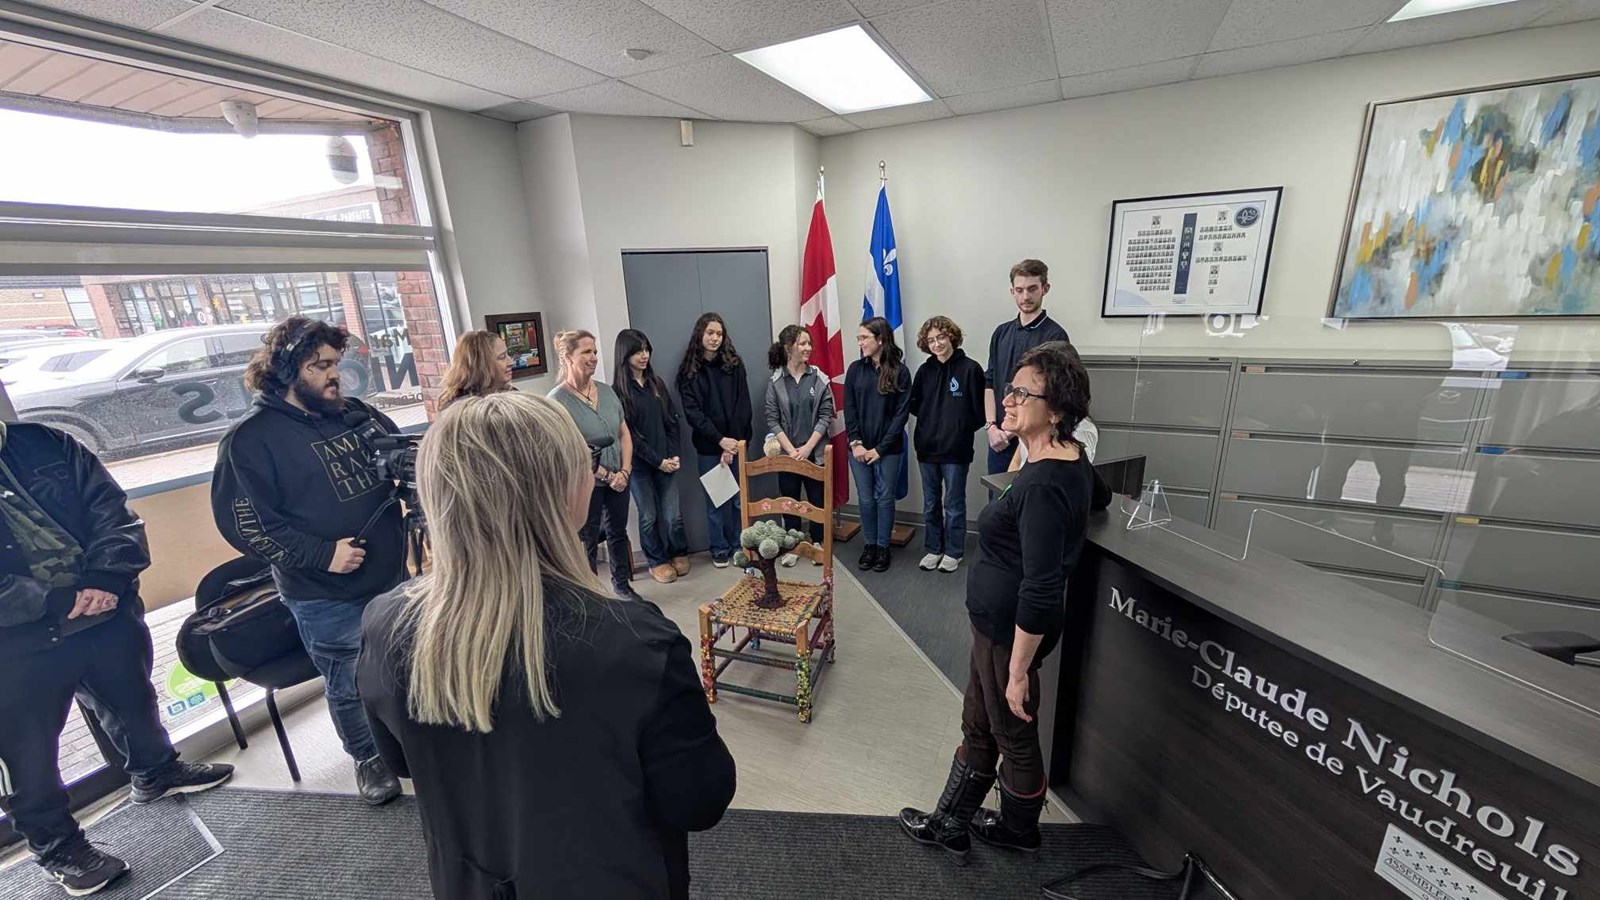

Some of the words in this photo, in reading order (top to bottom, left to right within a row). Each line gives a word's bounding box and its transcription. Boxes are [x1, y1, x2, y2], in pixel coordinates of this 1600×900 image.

[337, 472, 373, 495] TH
[1109, 587, 1329, 731] Marie-Claude
[1341, 717, 1580, 876] Nichols
[1305, 742, 1344, 776] de
